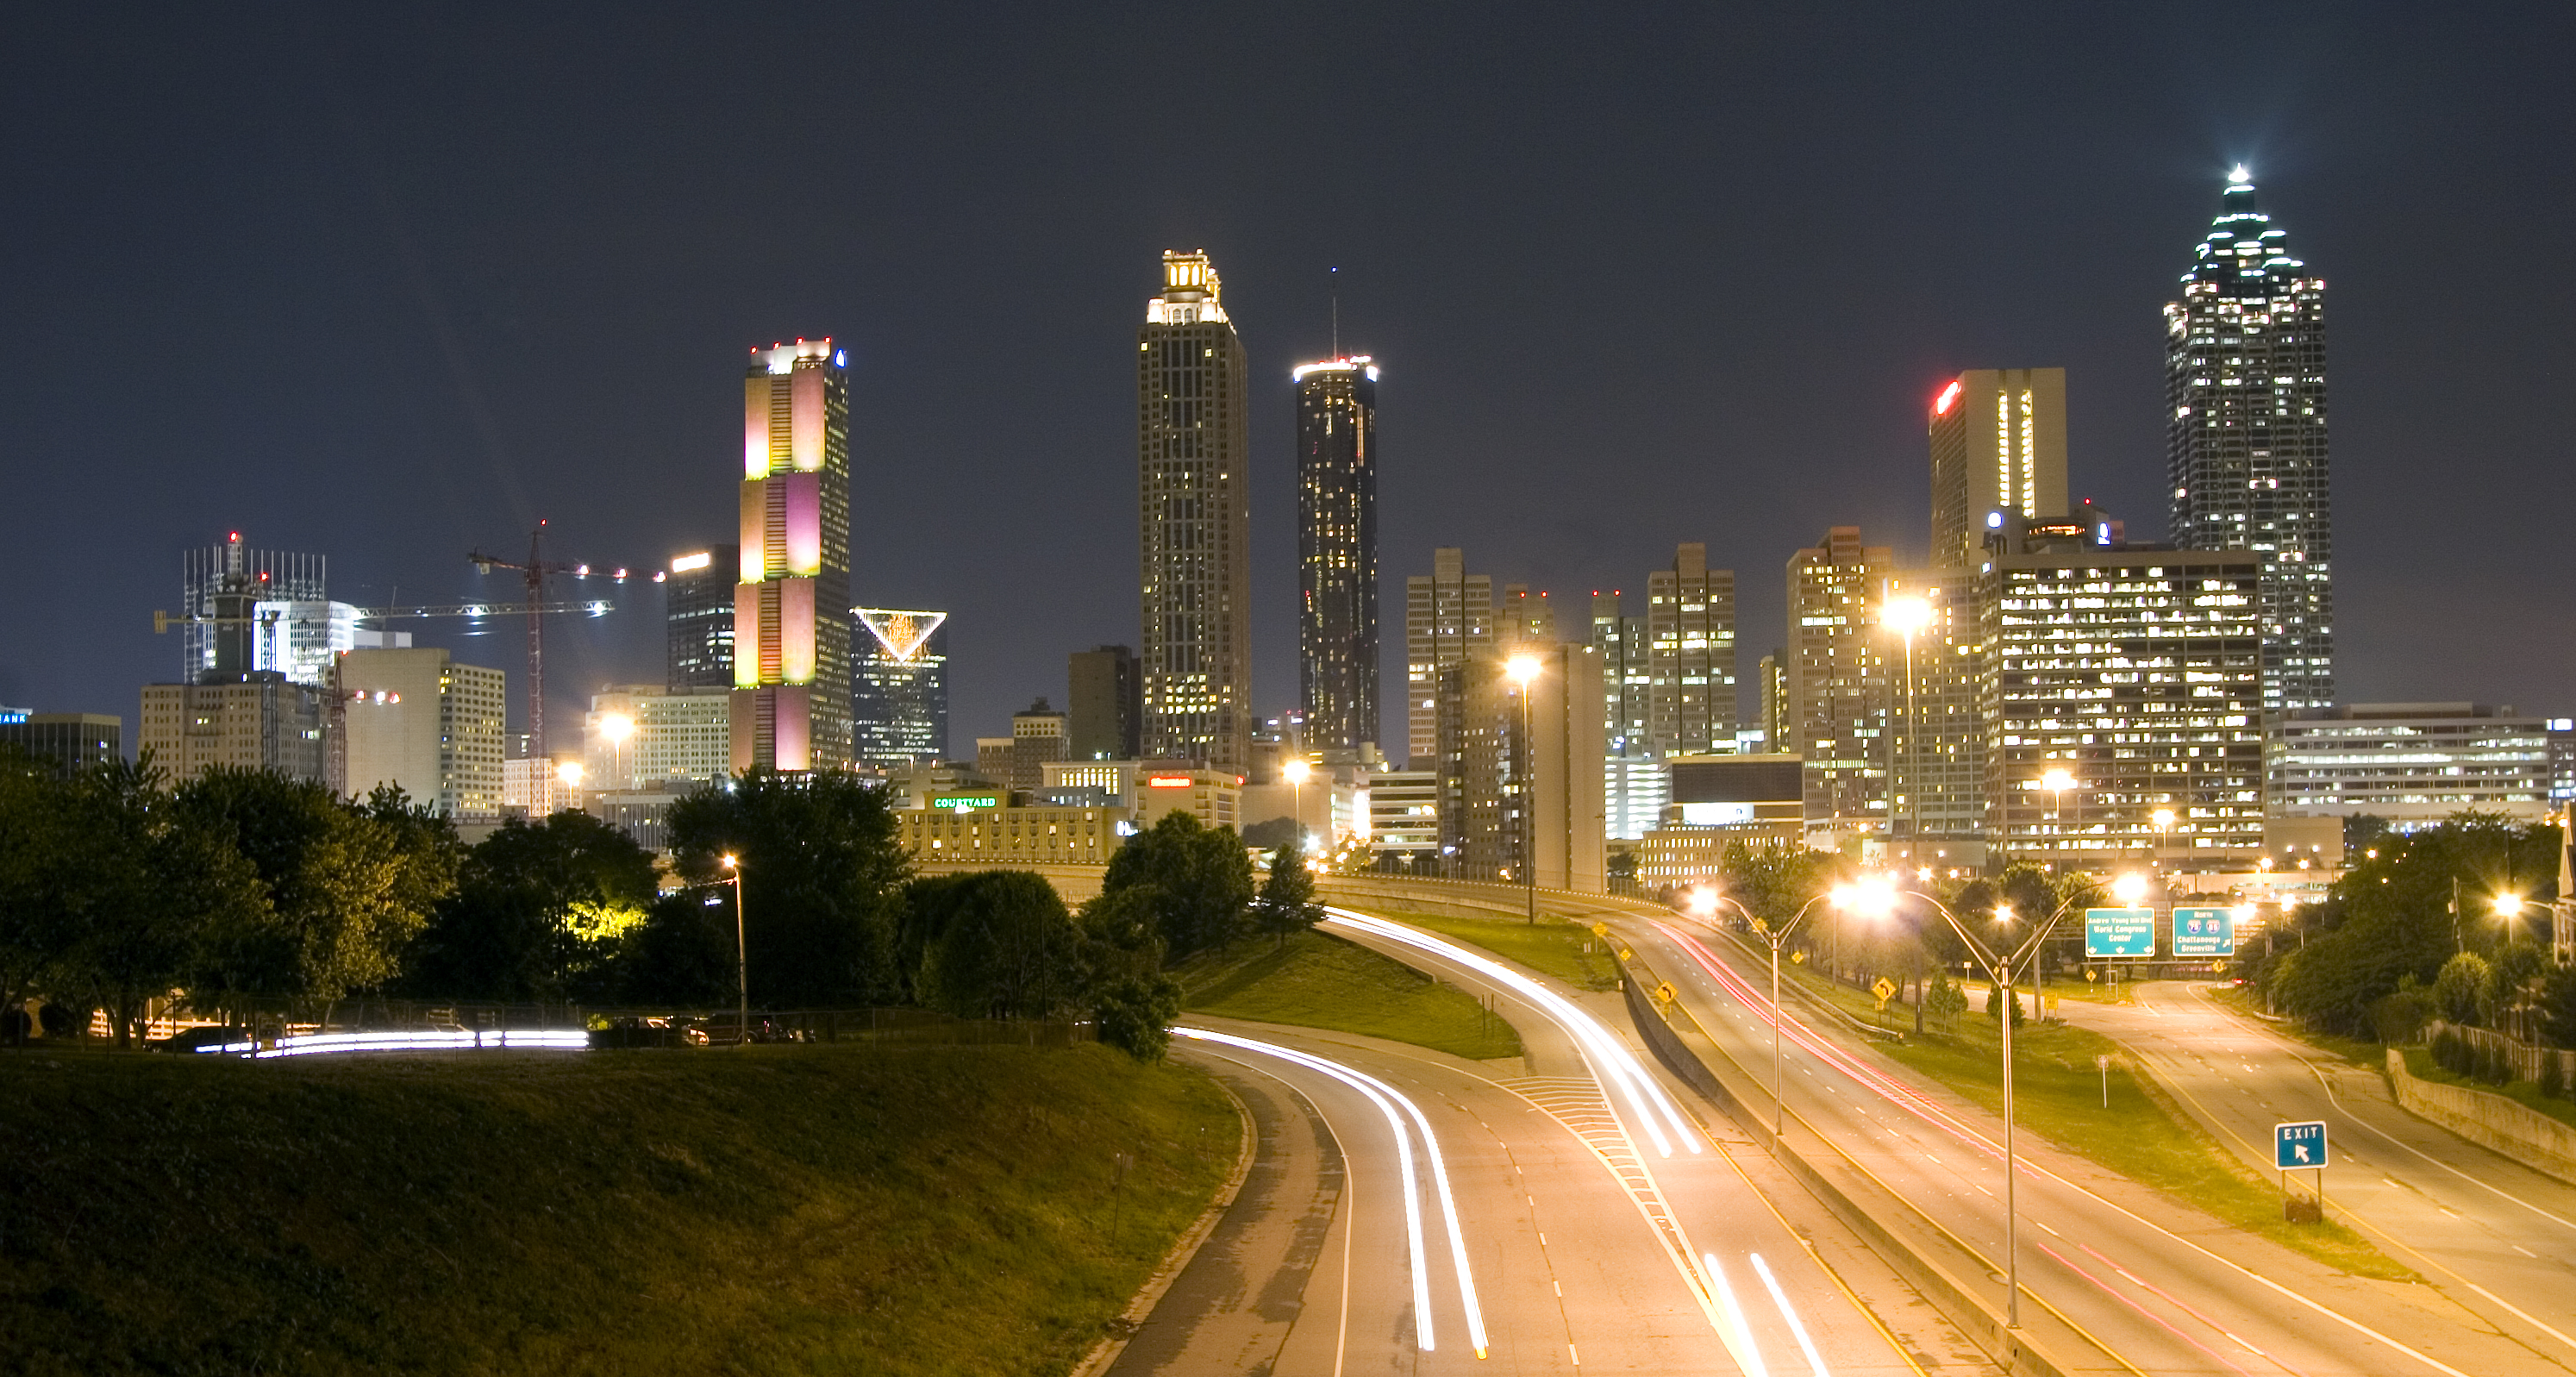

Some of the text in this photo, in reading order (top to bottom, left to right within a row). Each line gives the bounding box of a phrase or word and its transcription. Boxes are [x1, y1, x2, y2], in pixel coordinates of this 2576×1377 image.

[0, 714, 26, 723] ANK
[935, 798, 996, 808] COURTYARD
[2115, 925, 2147, 935] Congress
[2177, 936, 2221, 944] Chattanooga
[2285, 1126, 2318, 1140] EXIT
